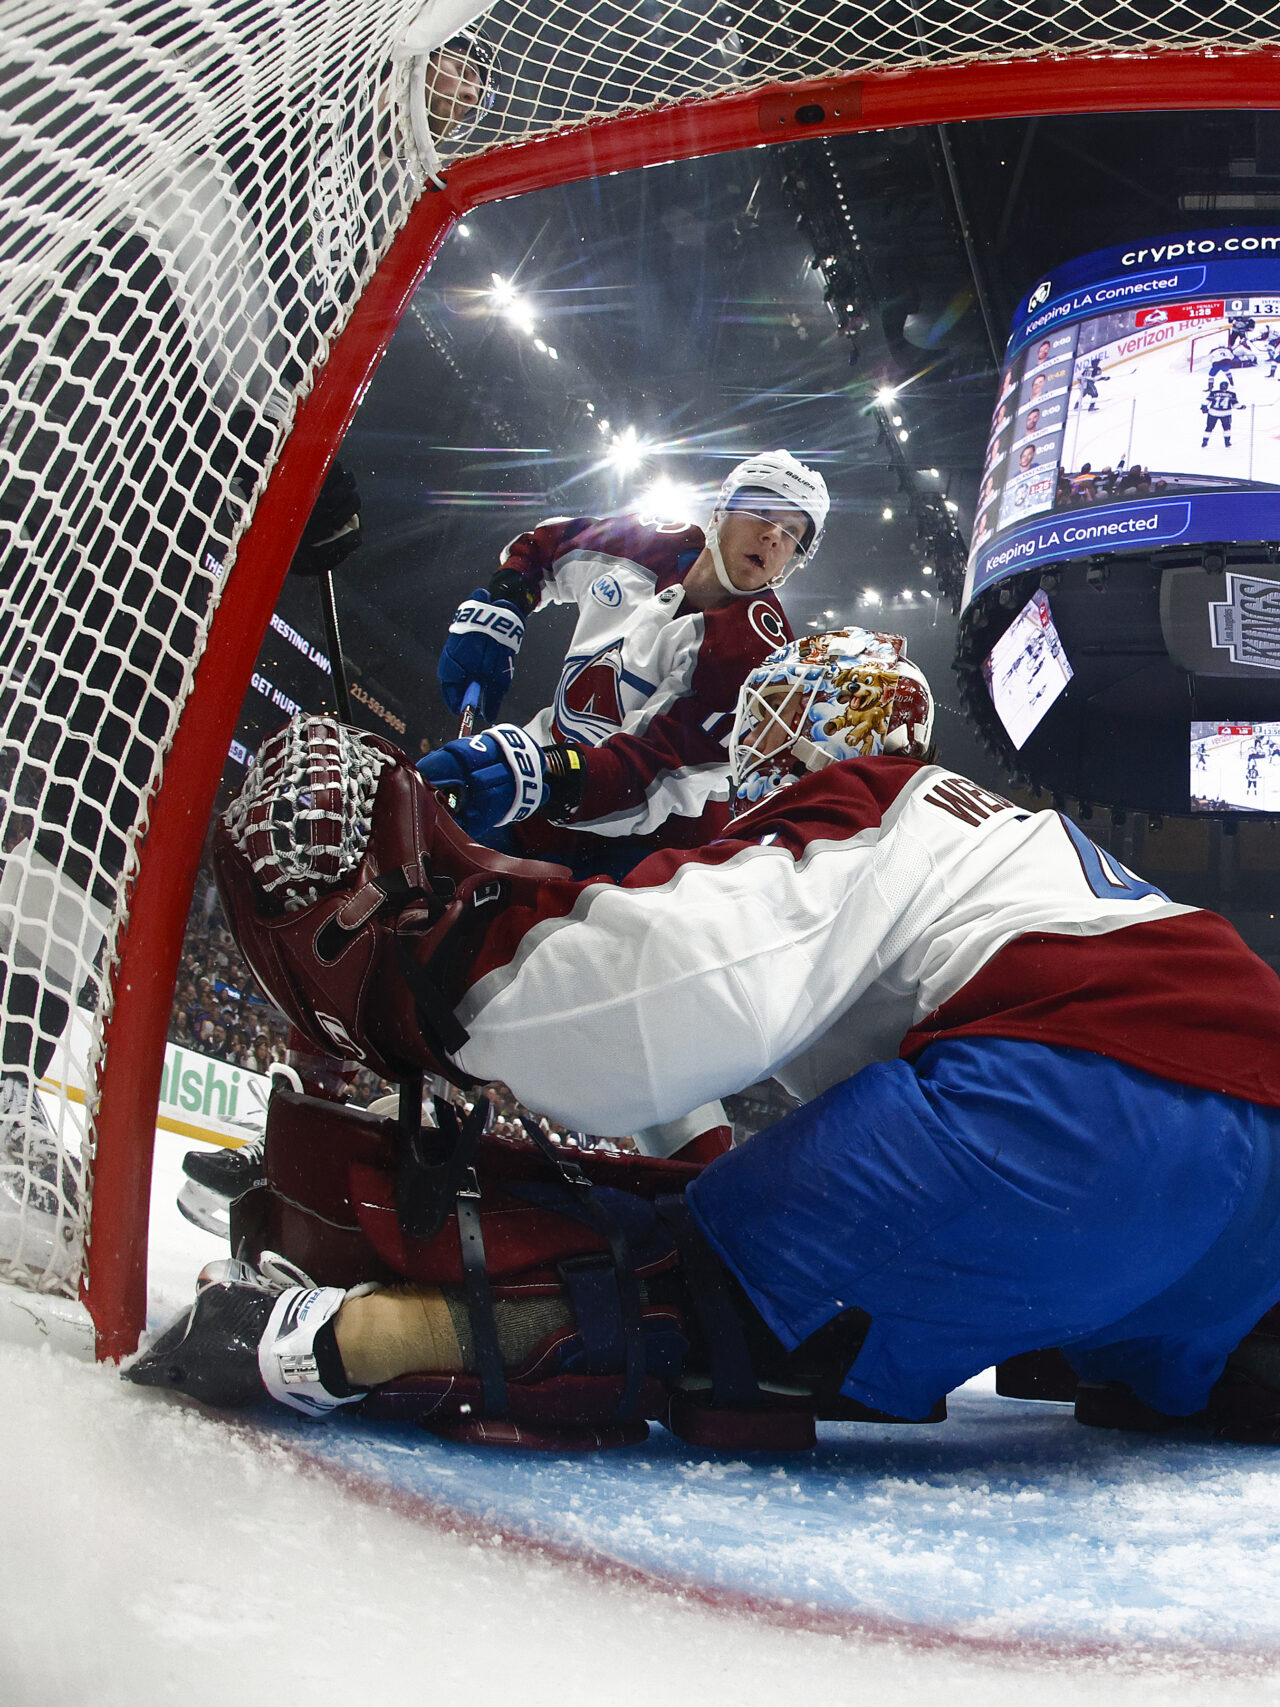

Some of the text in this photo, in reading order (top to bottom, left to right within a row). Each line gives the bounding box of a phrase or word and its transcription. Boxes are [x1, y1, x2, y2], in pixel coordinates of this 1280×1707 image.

[1025, 275, 1178, 336] Keeping LA Connected
[1231, 300, 1243, 310] 0
[1117, 324, 1174, 356] verizon
[985, 514, 1158, 573] Keeping LA Connected
[596, 577, 616, 602] IMA
[250, 672, 273, 697] GET
